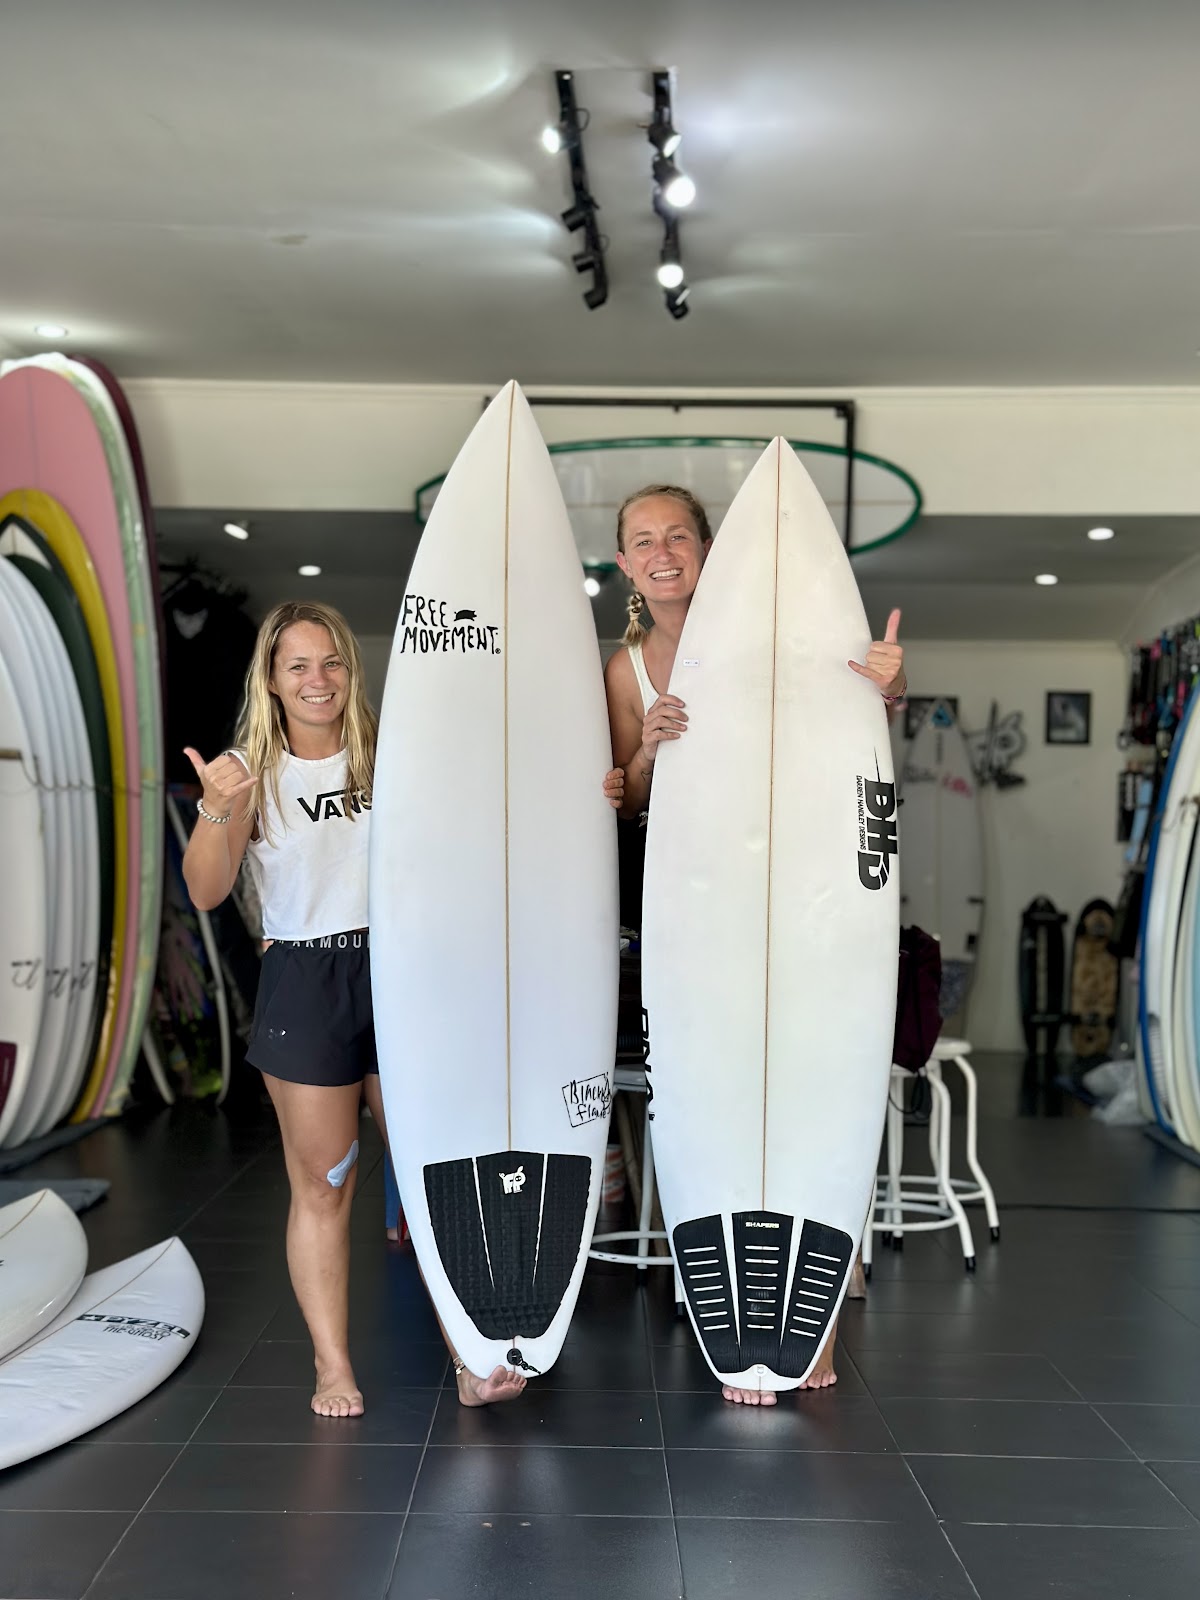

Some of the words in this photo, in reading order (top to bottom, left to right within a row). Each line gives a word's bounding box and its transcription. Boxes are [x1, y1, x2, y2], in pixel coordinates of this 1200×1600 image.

[401, 594, 449, 628] FREE
[856, 774, 864, 798] DARREN
[857, 798, 865, 826] HANDLEY
[857, 778, 898, 891] DHD
[858, 826, 867, 851] DESIGNS
[745, 1221, 780, 1229] SHAPERS
